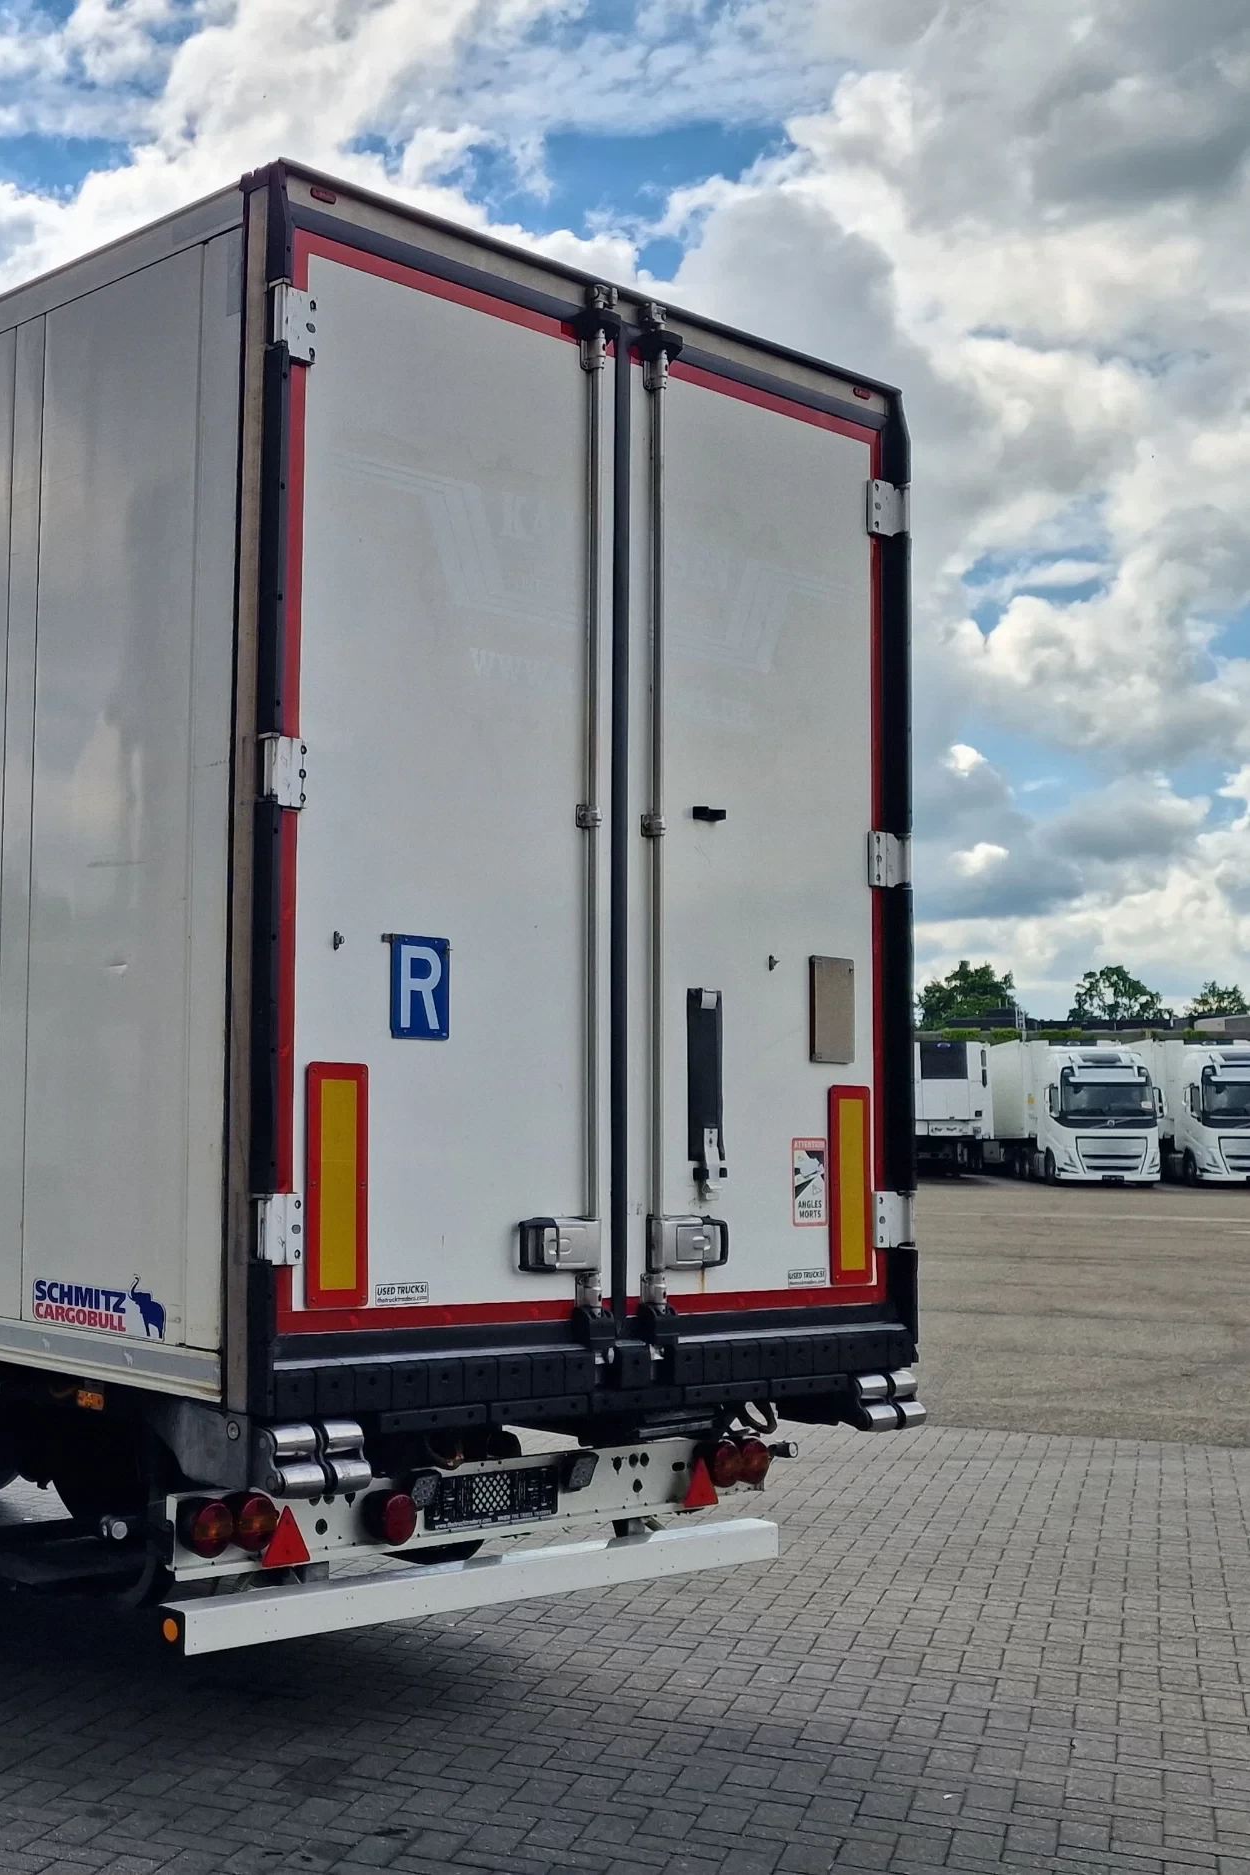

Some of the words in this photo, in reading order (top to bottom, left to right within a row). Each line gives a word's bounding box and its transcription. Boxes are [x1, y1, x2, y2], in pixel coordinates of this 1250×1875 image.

[401, 945, 441, 1029] R
[798, 1200, 822, 1209] ANGLES
[799, 1210, 821, 1218] MORTS
[35, 1280, 126, 1314] SCHMITZ
[377, 1287, 396, 1296] USED
[35, 1302, 126, 1332] CARGOBULL
